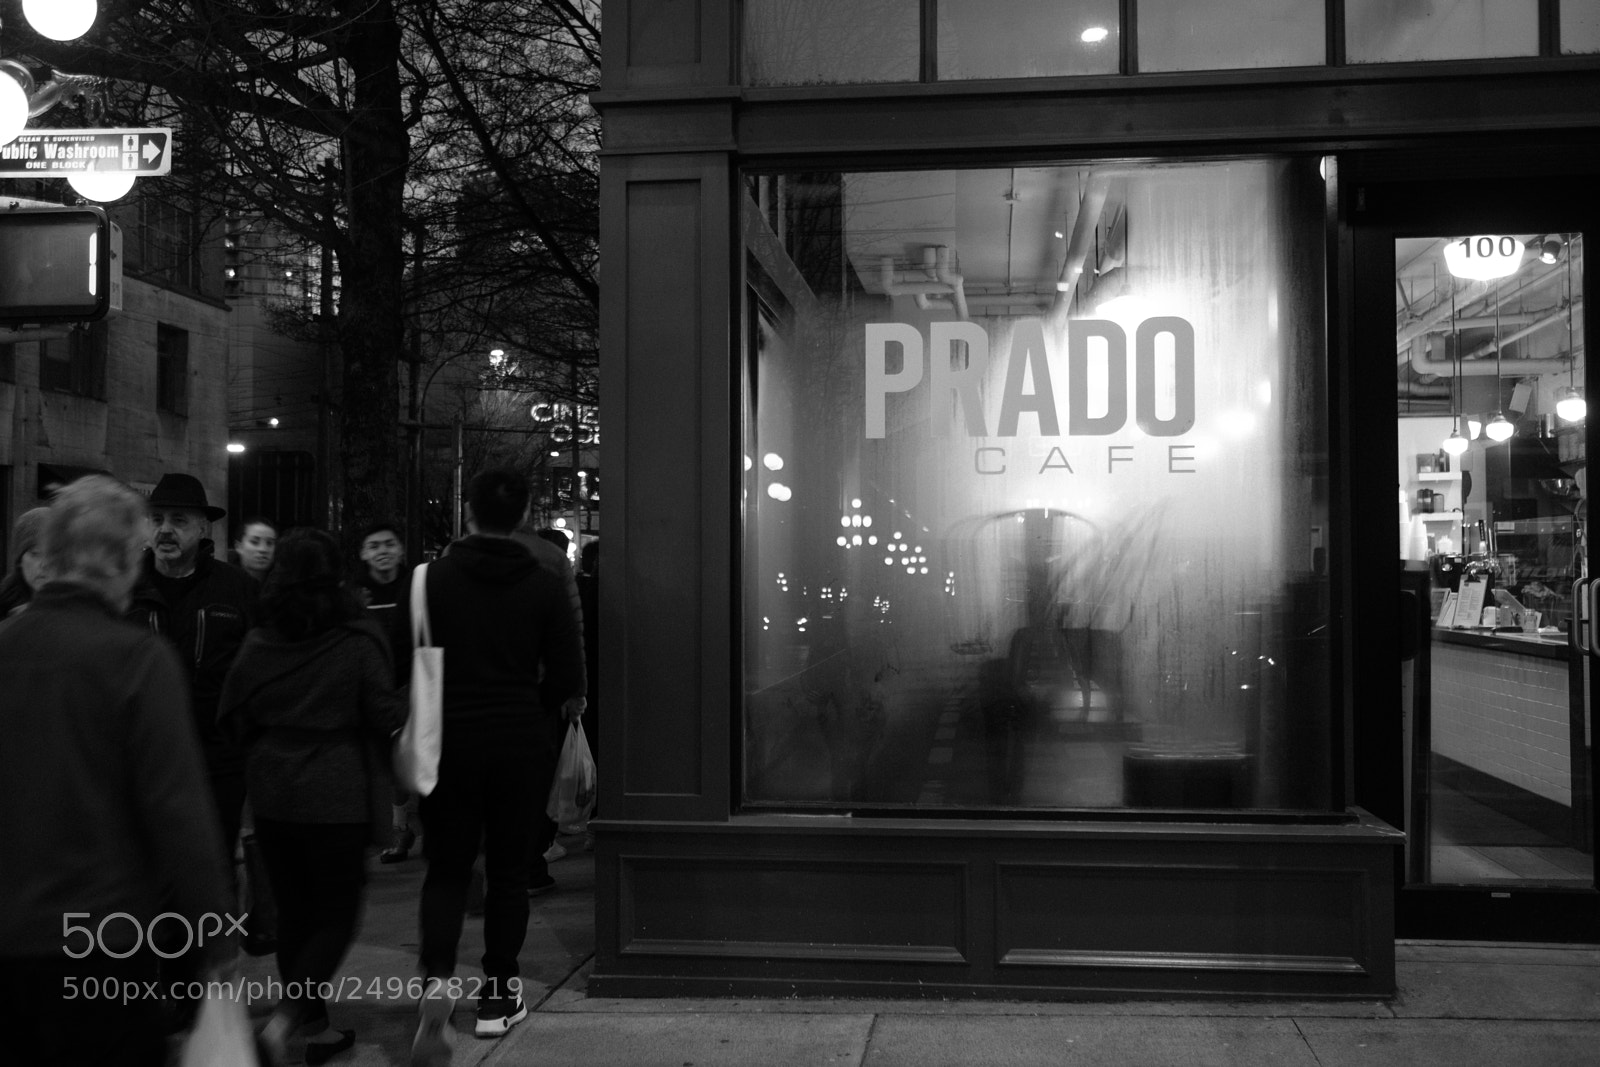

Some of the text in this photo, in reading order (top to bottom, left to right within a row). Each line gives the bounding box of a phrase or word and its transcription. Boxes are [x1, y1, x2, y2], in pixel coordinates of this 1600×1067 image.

[0, 143, 119, 160] ublic Washroom
[25, 161, 86, 169] ONE BLOCK
[1459, 236, 1516, 258] 100
[865, 316, 1195, 439] PRADO
[974, 445, 1196, 475] CAFE
